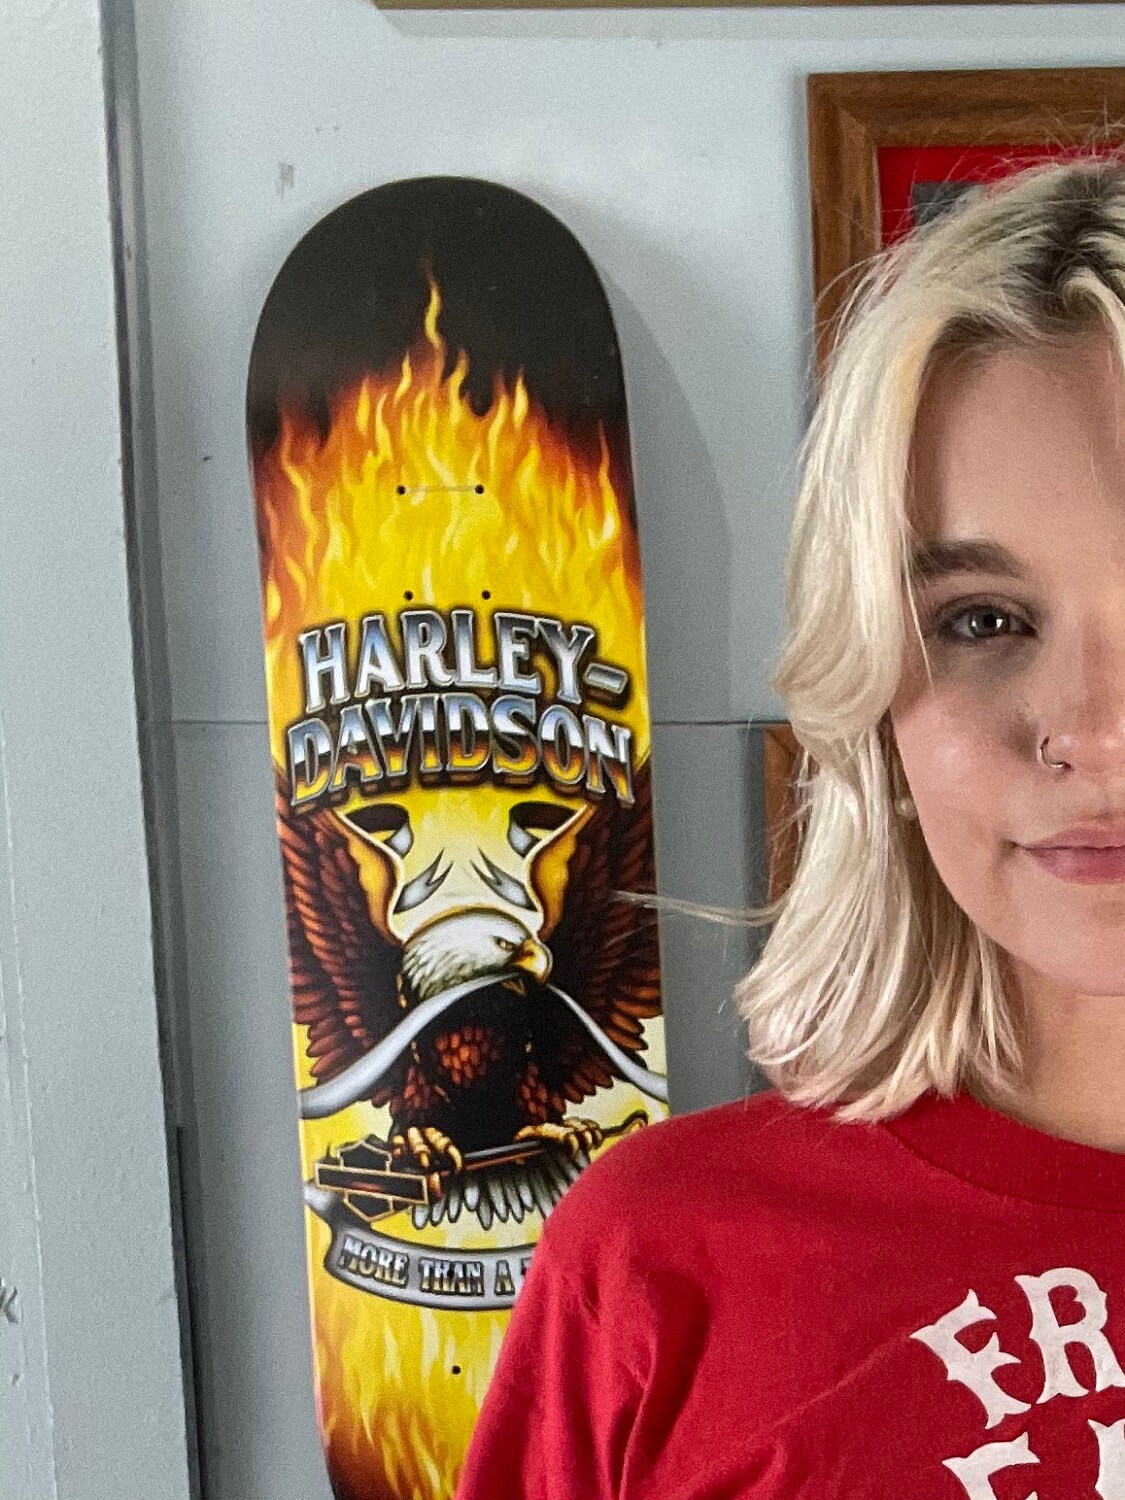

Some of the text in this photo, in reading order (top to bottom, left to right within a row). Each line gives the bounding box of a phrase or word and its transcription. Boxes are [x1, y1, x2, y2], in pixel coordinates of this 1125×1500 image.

[300, 609, 628, 713] HARLEY-
[287, 693, 634, 805] DAVIDSON
[340, 1235, 409, 1287] MORE
[418, 1256, 484, 1296] THAN
[494, 1259, 515, 1296] A
